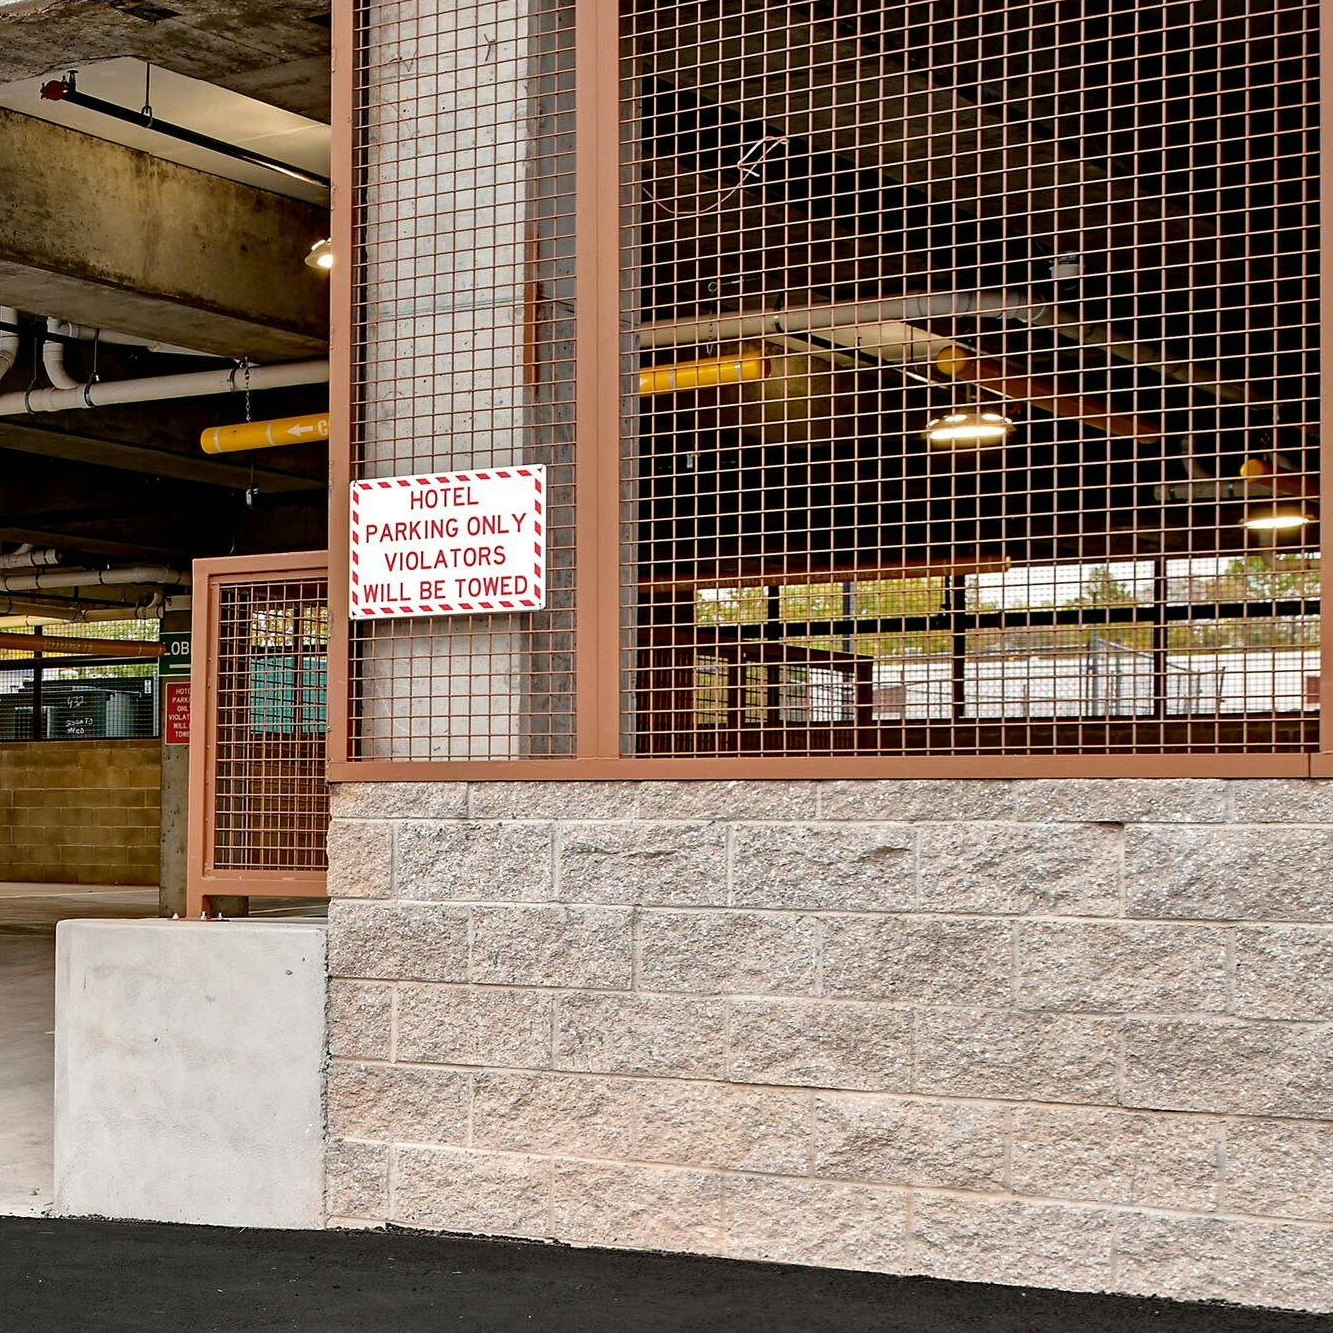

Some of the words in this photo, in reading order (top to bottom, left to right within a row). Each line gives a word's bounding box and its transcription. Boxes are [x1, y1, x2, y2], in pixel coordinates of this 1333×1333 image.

[410, 486, 479, 510] HOTEL
[365, 517, 459, 544] PARKING
[466, 512, 528, 537] ONLY
[384, 545, 507, 572] VIOLATORS
[363, 582, 412, 604] WILL
[419, 579, 446, 601] BE
[454, 575, 528, 598] TOWED
